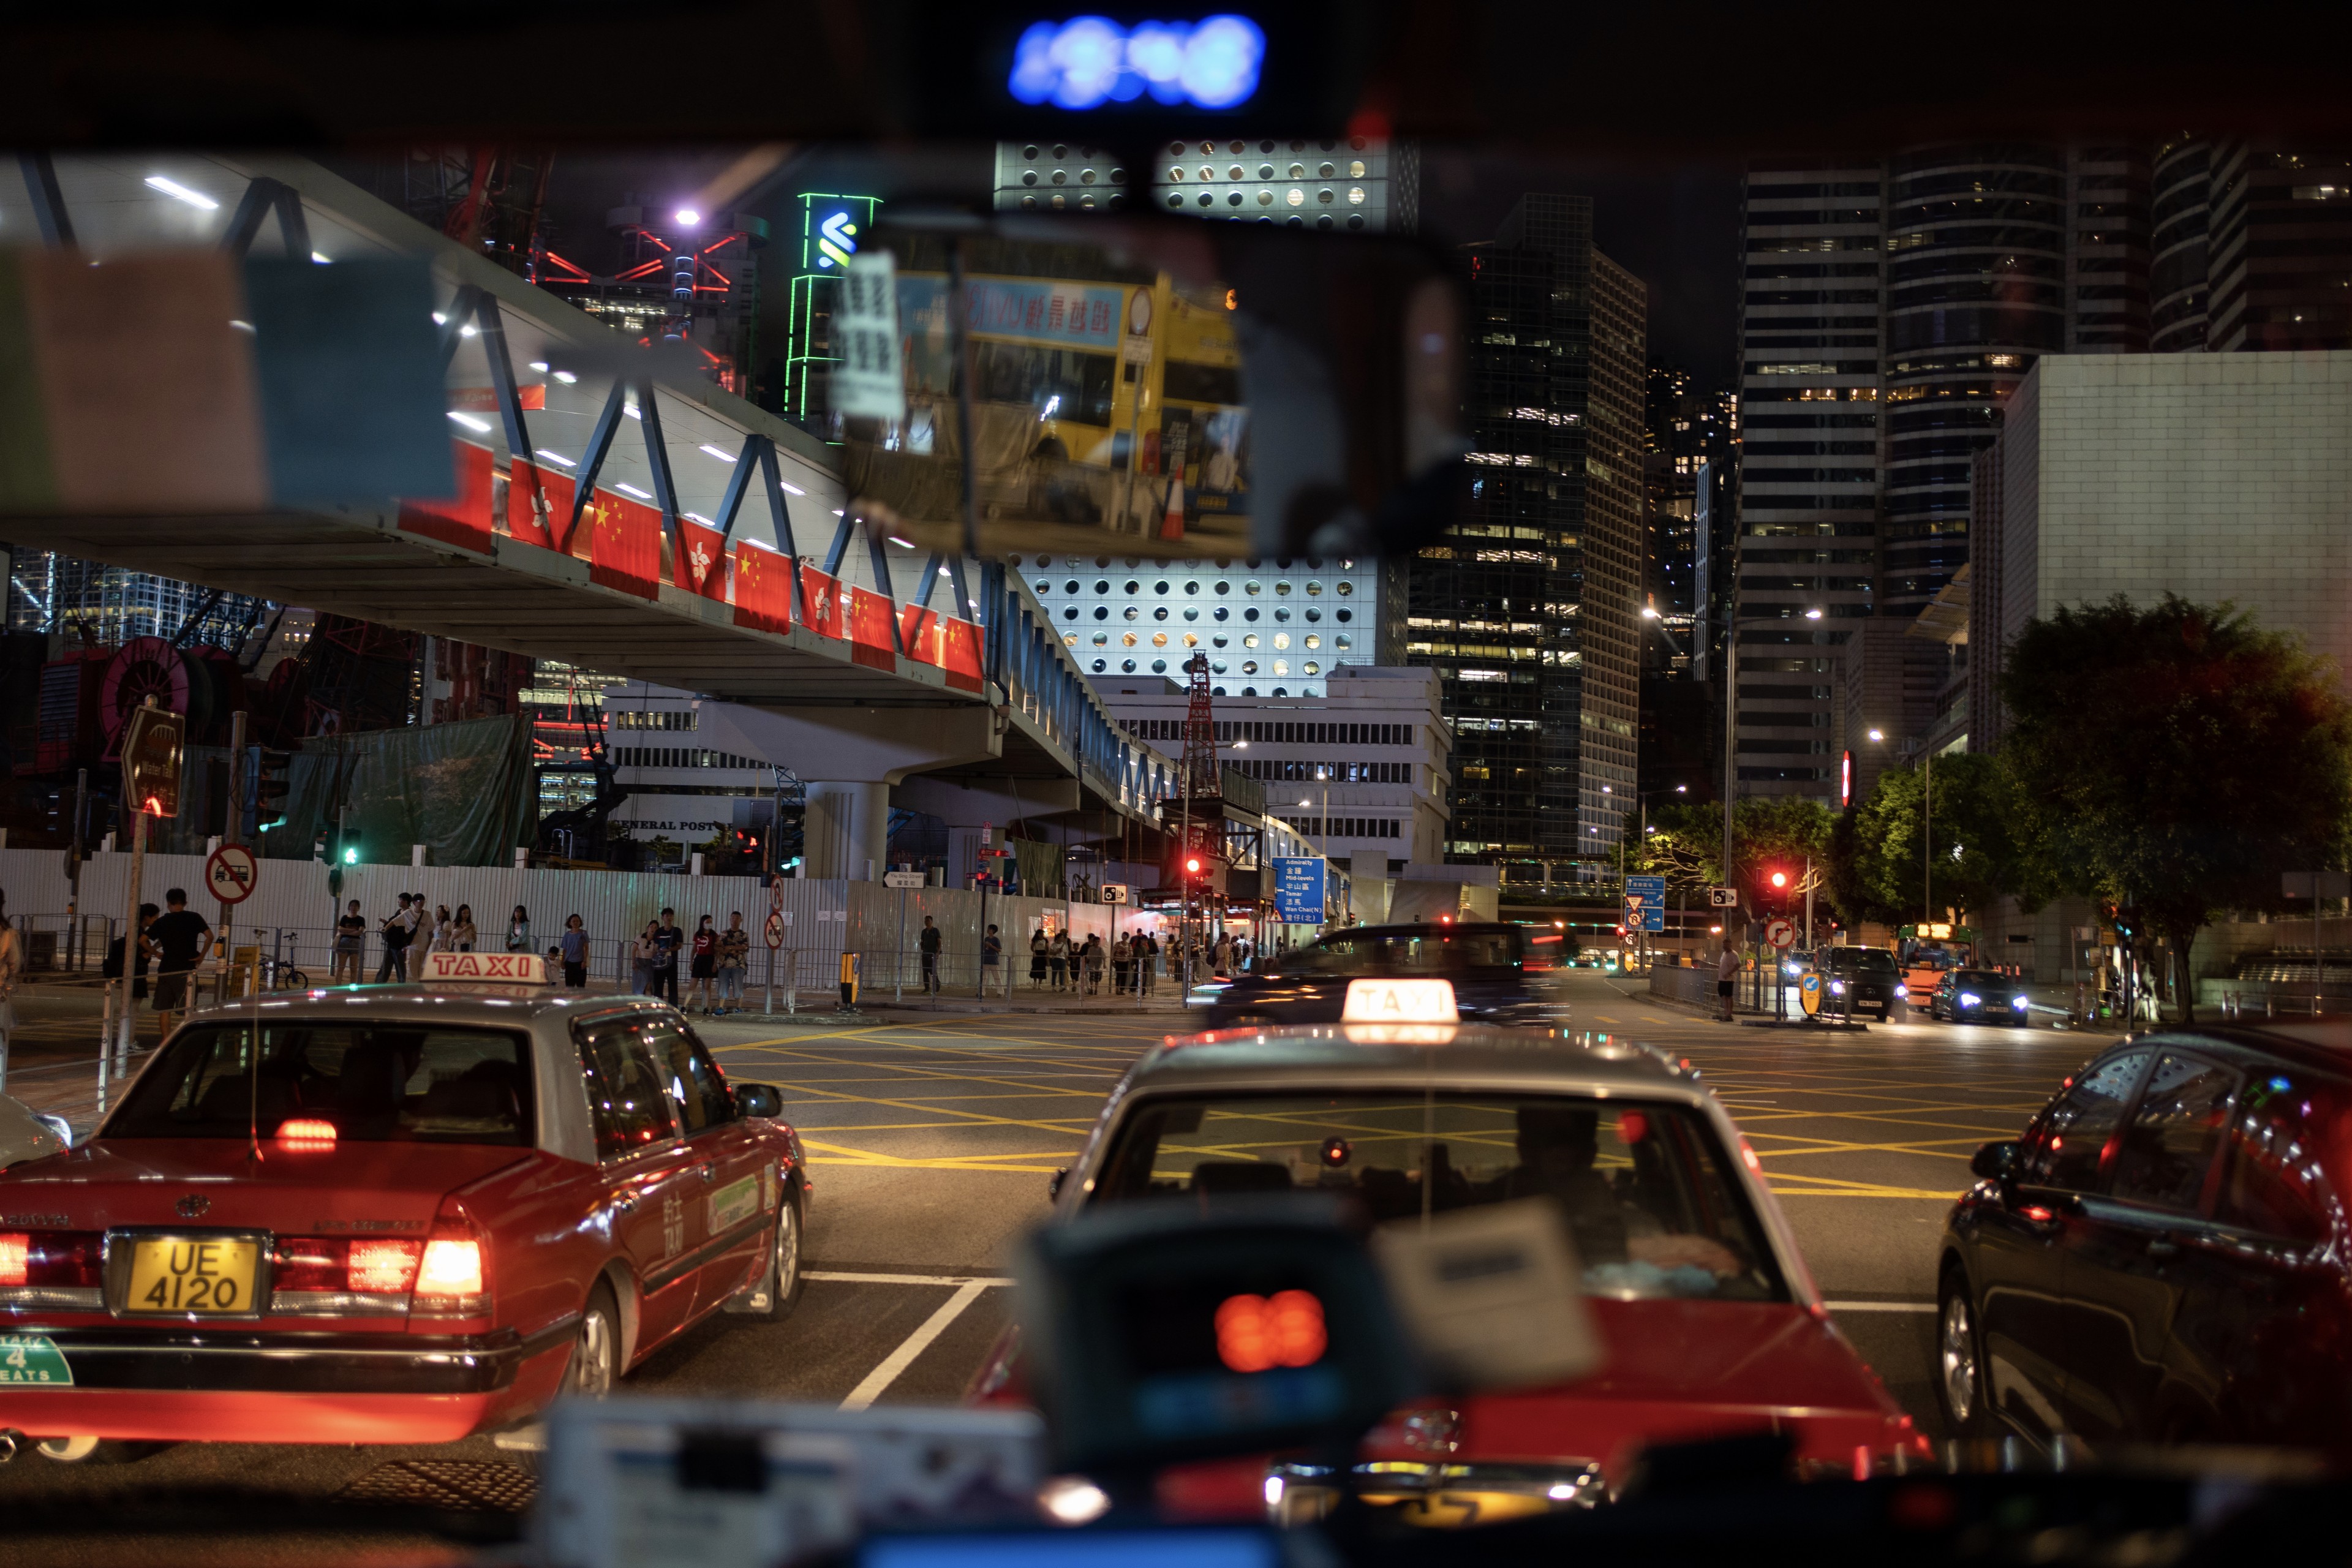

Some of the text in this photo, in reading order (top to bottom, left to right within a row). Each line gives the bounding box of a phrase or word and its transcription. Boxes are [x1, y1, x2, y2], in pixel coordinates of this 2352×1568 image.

[141, 760, 160, 775] Water
[680, 821, 715, 831] POST
[433, 954, 530, 977] TAXI
[1358, 989, 1443, 1013] TAXI
[663, 1221, 683, 1259] TAXI
[170, 1244, 221, 1276] UE
[144, 1276, 238, 1308] 4120
[6, 1348, 27, 1368] 4
